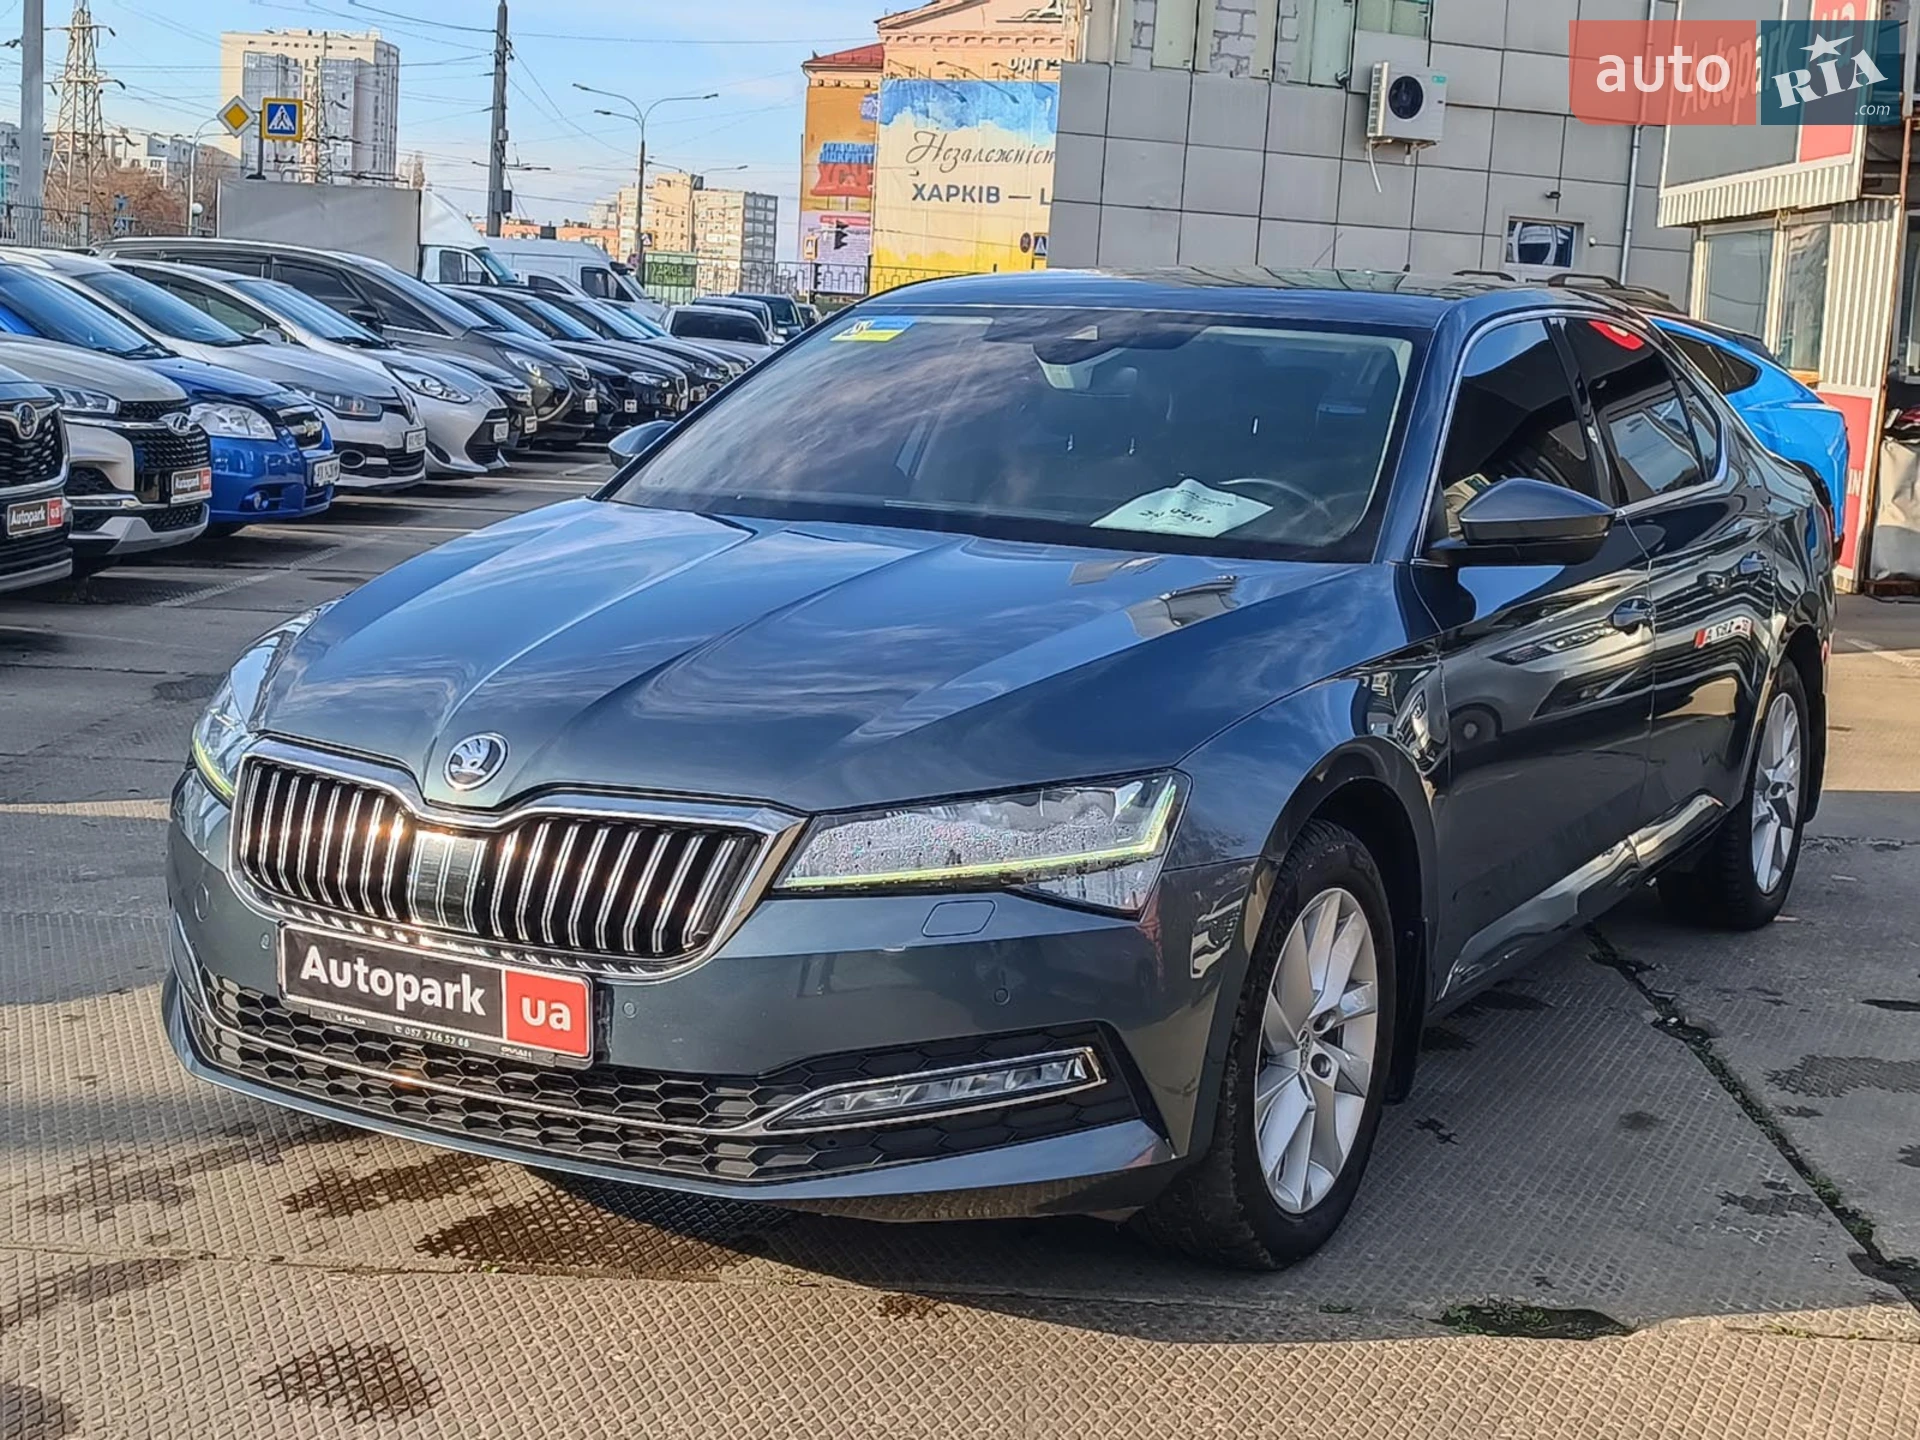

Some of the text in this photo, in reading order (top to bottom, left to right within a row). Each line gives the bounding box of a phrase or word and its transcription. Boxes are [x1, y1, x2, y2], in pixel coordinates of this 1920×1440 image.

[911, 183, 1001, 204] ХАРКІВ
[11, 504, 46, 528] Autopark
[300, 945, 572, 1031] Autopark ua
